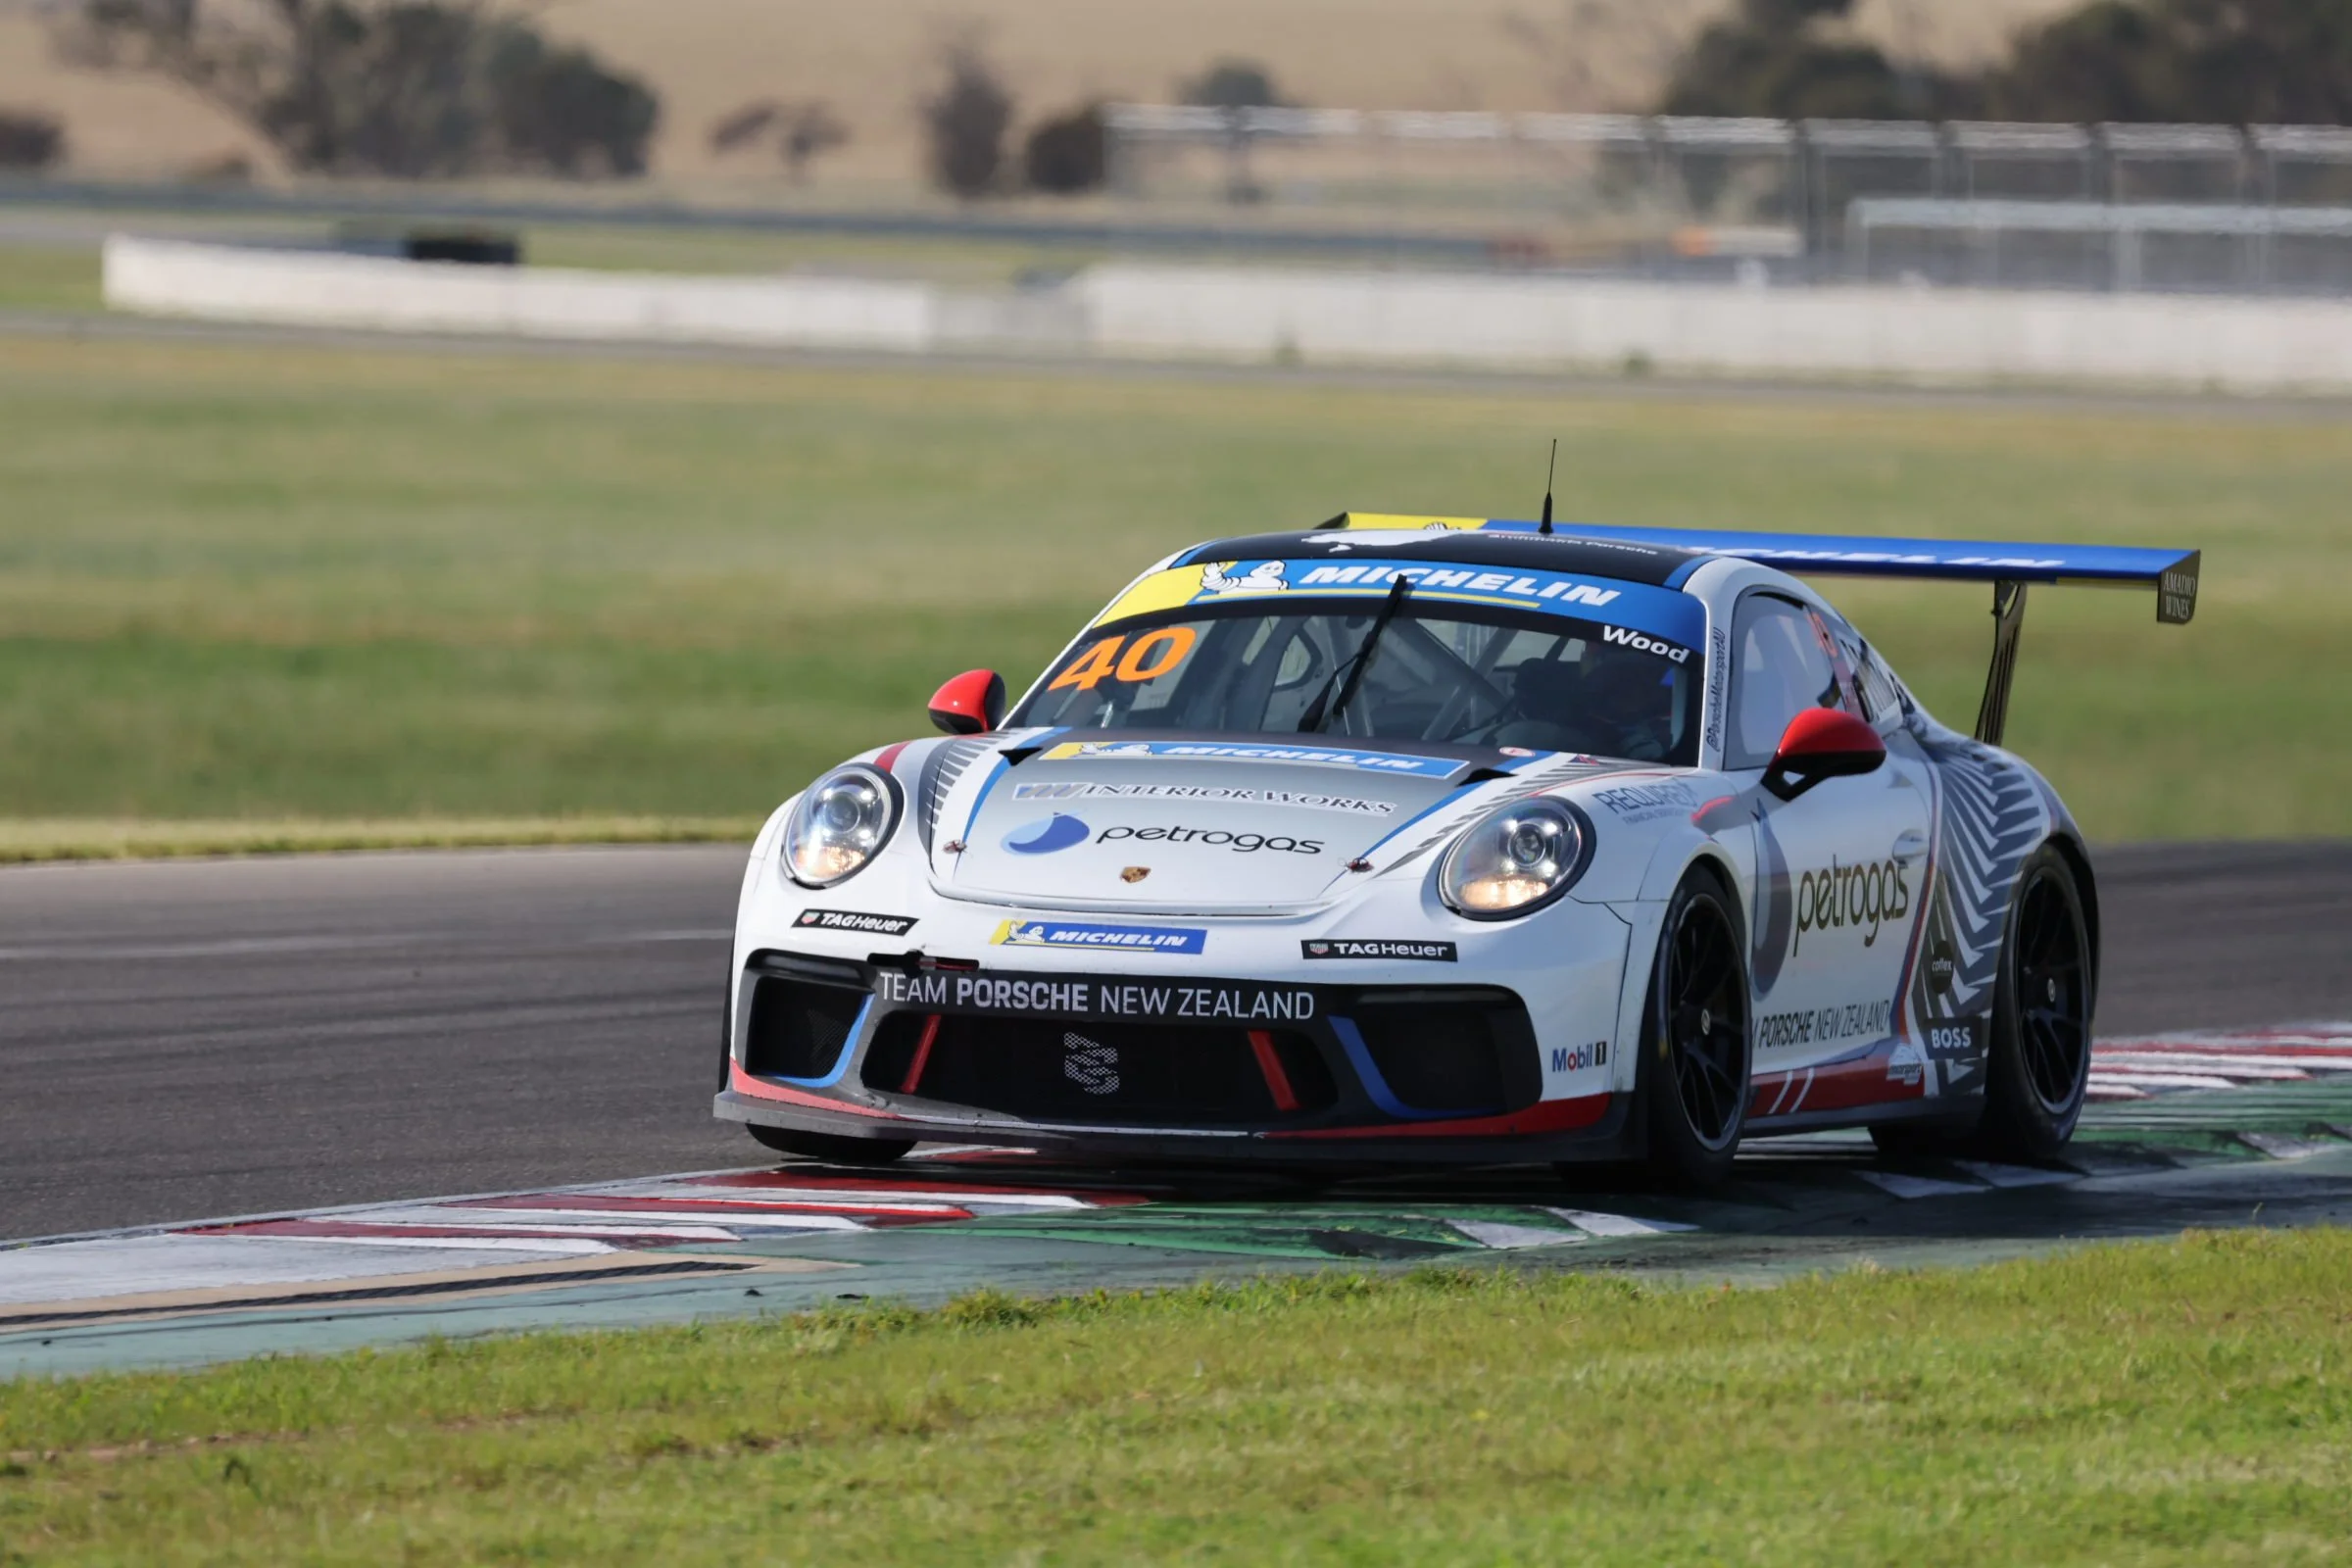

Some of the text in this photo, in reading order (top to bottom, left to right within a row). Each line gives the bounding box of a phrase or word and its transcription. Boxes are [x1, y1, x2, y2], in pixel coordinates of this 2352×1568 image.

[1298, 565, 1623, 607] MICHELIN
[2162, 571, 2196, 597] AMADIO
[2165, 594, 2191, 619] WINES
[1047, 626, 1198, 691] 40
[1602, 624, 1690, 664] Wood
[1162, 746, 1424, 769] MICHELIN
[1085, 784, 1397, 815] INTERIOR WORKS
[1096, 825, 1325, 854] petrogas
[1792, 854, 1909, 958] petrogas
[1050, 931, 1188, 947] MICHELIN
[880, 971, 1315, 1021] TEAM PORSCHE NEW ZEALAND
[1759, 1010, 1814, 1049] PORSCHE
[1814, 1007, 1842, 1041] NEW
[1841, 1000, 1889, 1036] ZEALAND
[1931, 1027, 1972, 1049] BOSS
[1552, 1041, 1607, 1073] Mobil 1
